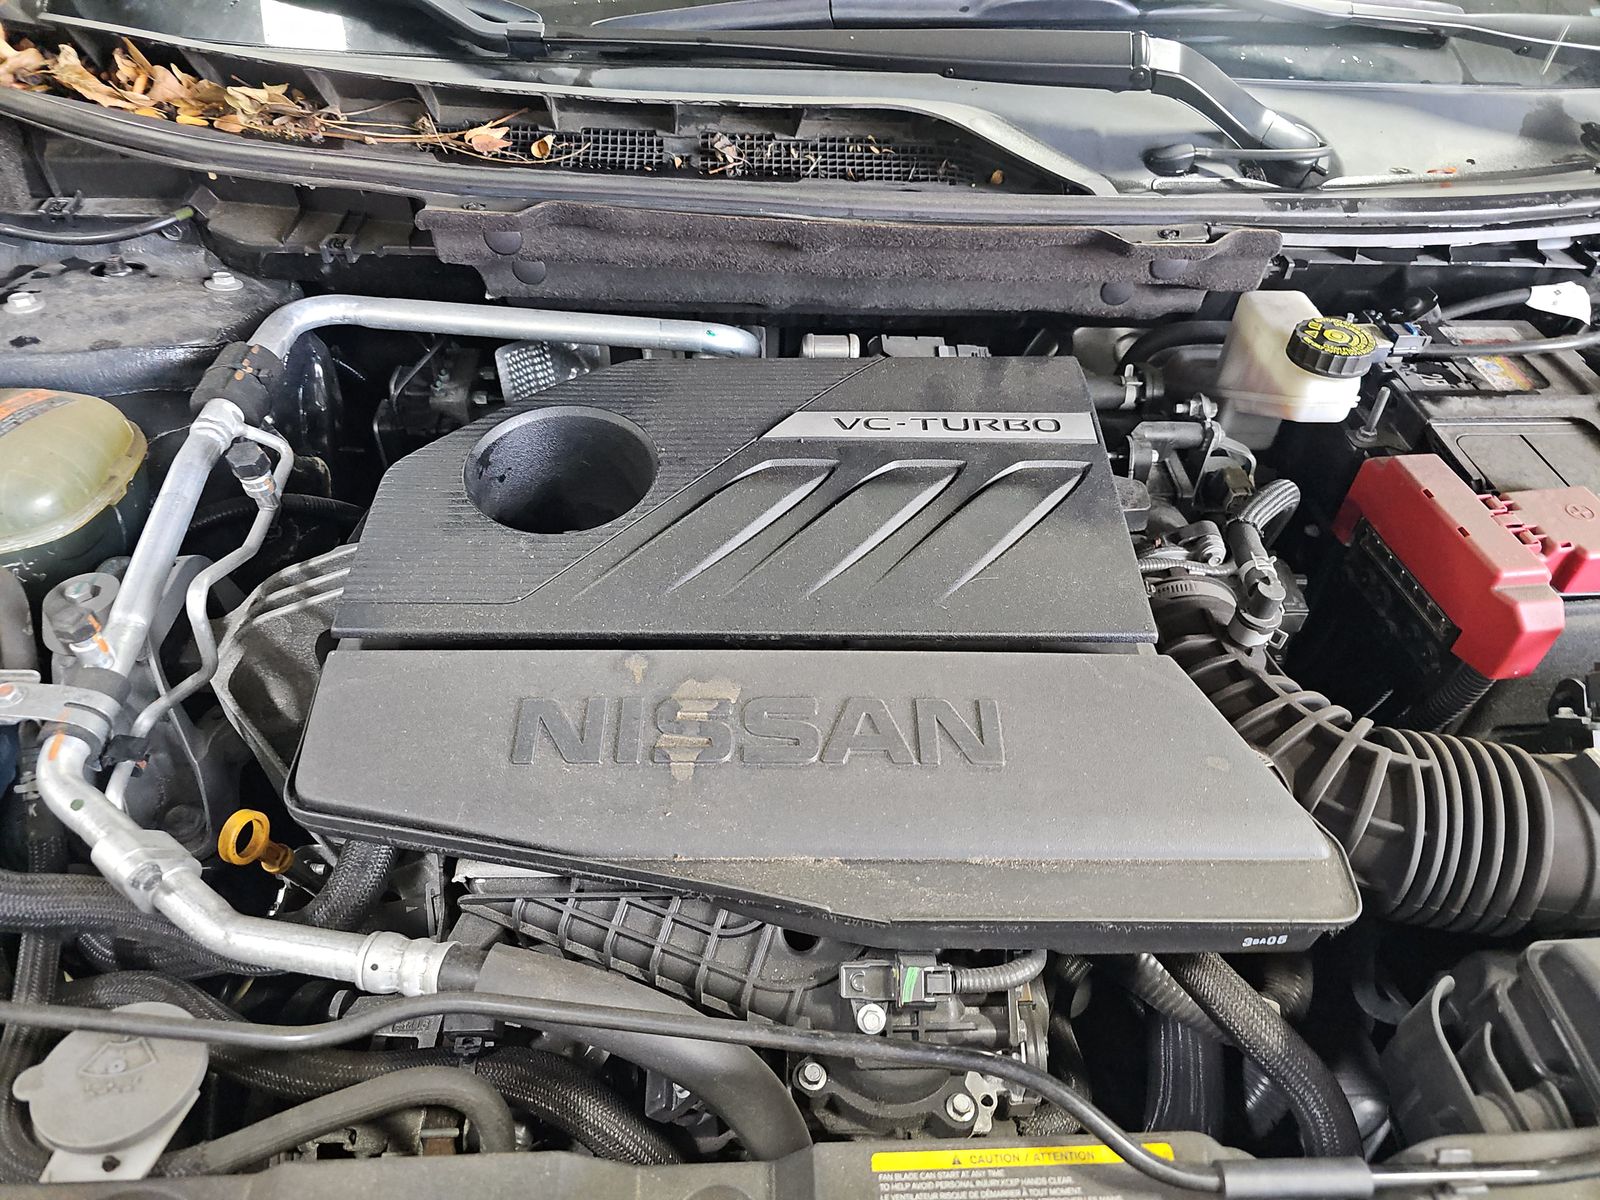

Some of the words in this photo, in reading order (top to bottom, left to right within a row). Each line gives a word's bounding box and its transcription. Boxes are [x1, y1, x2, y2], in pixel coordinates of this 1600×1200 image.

[833, 416, 1062, 433] VC-TURBO
[510, 695, 1006, 767] NISSAN
[970, 1153, 1020, 1164] CAUTION
[1033, 1151, 1095, 1161] ATTENTION
[878, 1172, 894, 1181] FAN
[894, 1171, 919, 1180] BLADE
[919, 1171, 936, 1180] CAN
[936, 1170, 961, 1179] START
[960, 1170, 970, 1179] AT
[970, 1169, 986, 1179] ANY
[880, 1182, 890, 1192] TO
[890, 1181, 911, 1191] HELP
[911, 1181, 935, 1191] AVOID
[935, 1179, 976, 1190] PERSONAL
[1021, 1176, 1047, 1186] HANDS
[890, 1191, 938, 1200] VENTILATEUR
[938, 1190, 967, 1200] RISQUE
[968, 1190, 979, 1199] DE
[1029, 1187, 1048, 1197] TOUT
